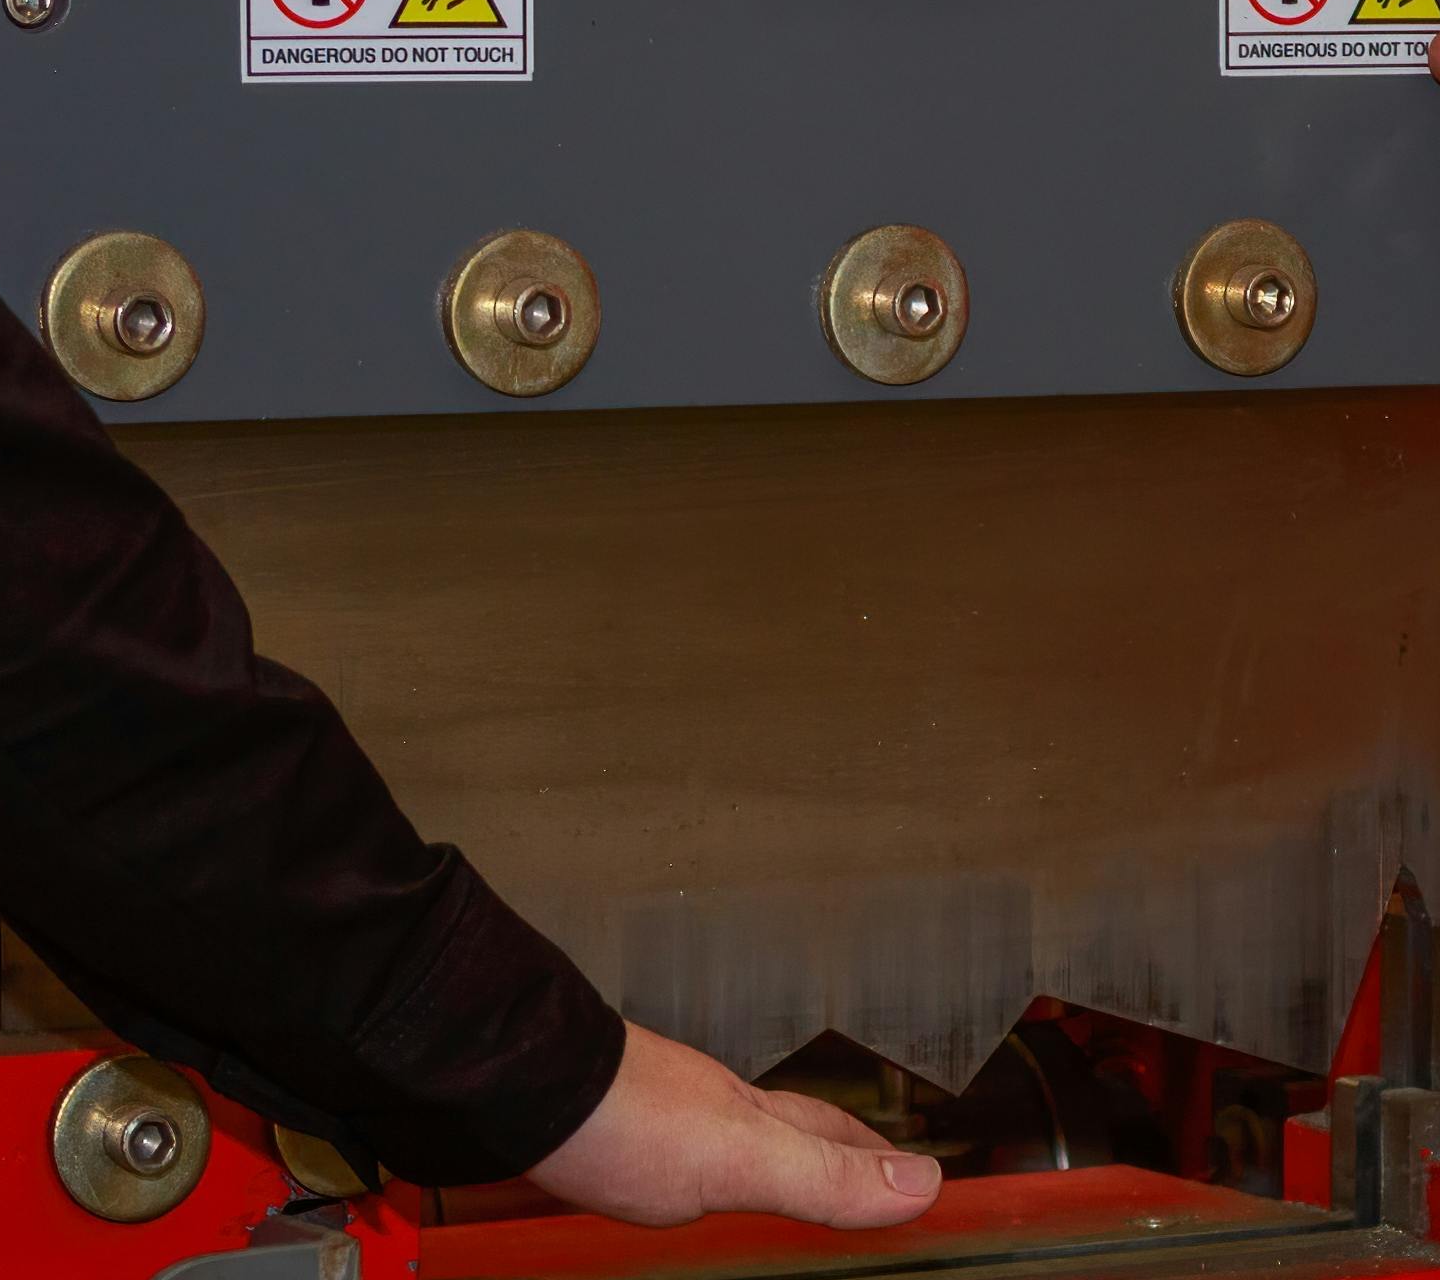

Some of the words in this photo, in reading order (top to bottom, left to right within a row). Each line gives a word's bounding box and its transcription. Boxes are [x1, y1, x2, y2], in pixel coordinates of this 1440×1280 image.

[262, 47, 376, 64] DANGEROUS
[381, 48, 408, 63] DO
[413, 47, 448, 63] NOT
[453, 47, 514, 63] TOUCH
[1238, 43, 1337, 58] DANGEROUS
[1342, 43, 1365, 58] DO
[1369, 42, 1401, 57] NOT
